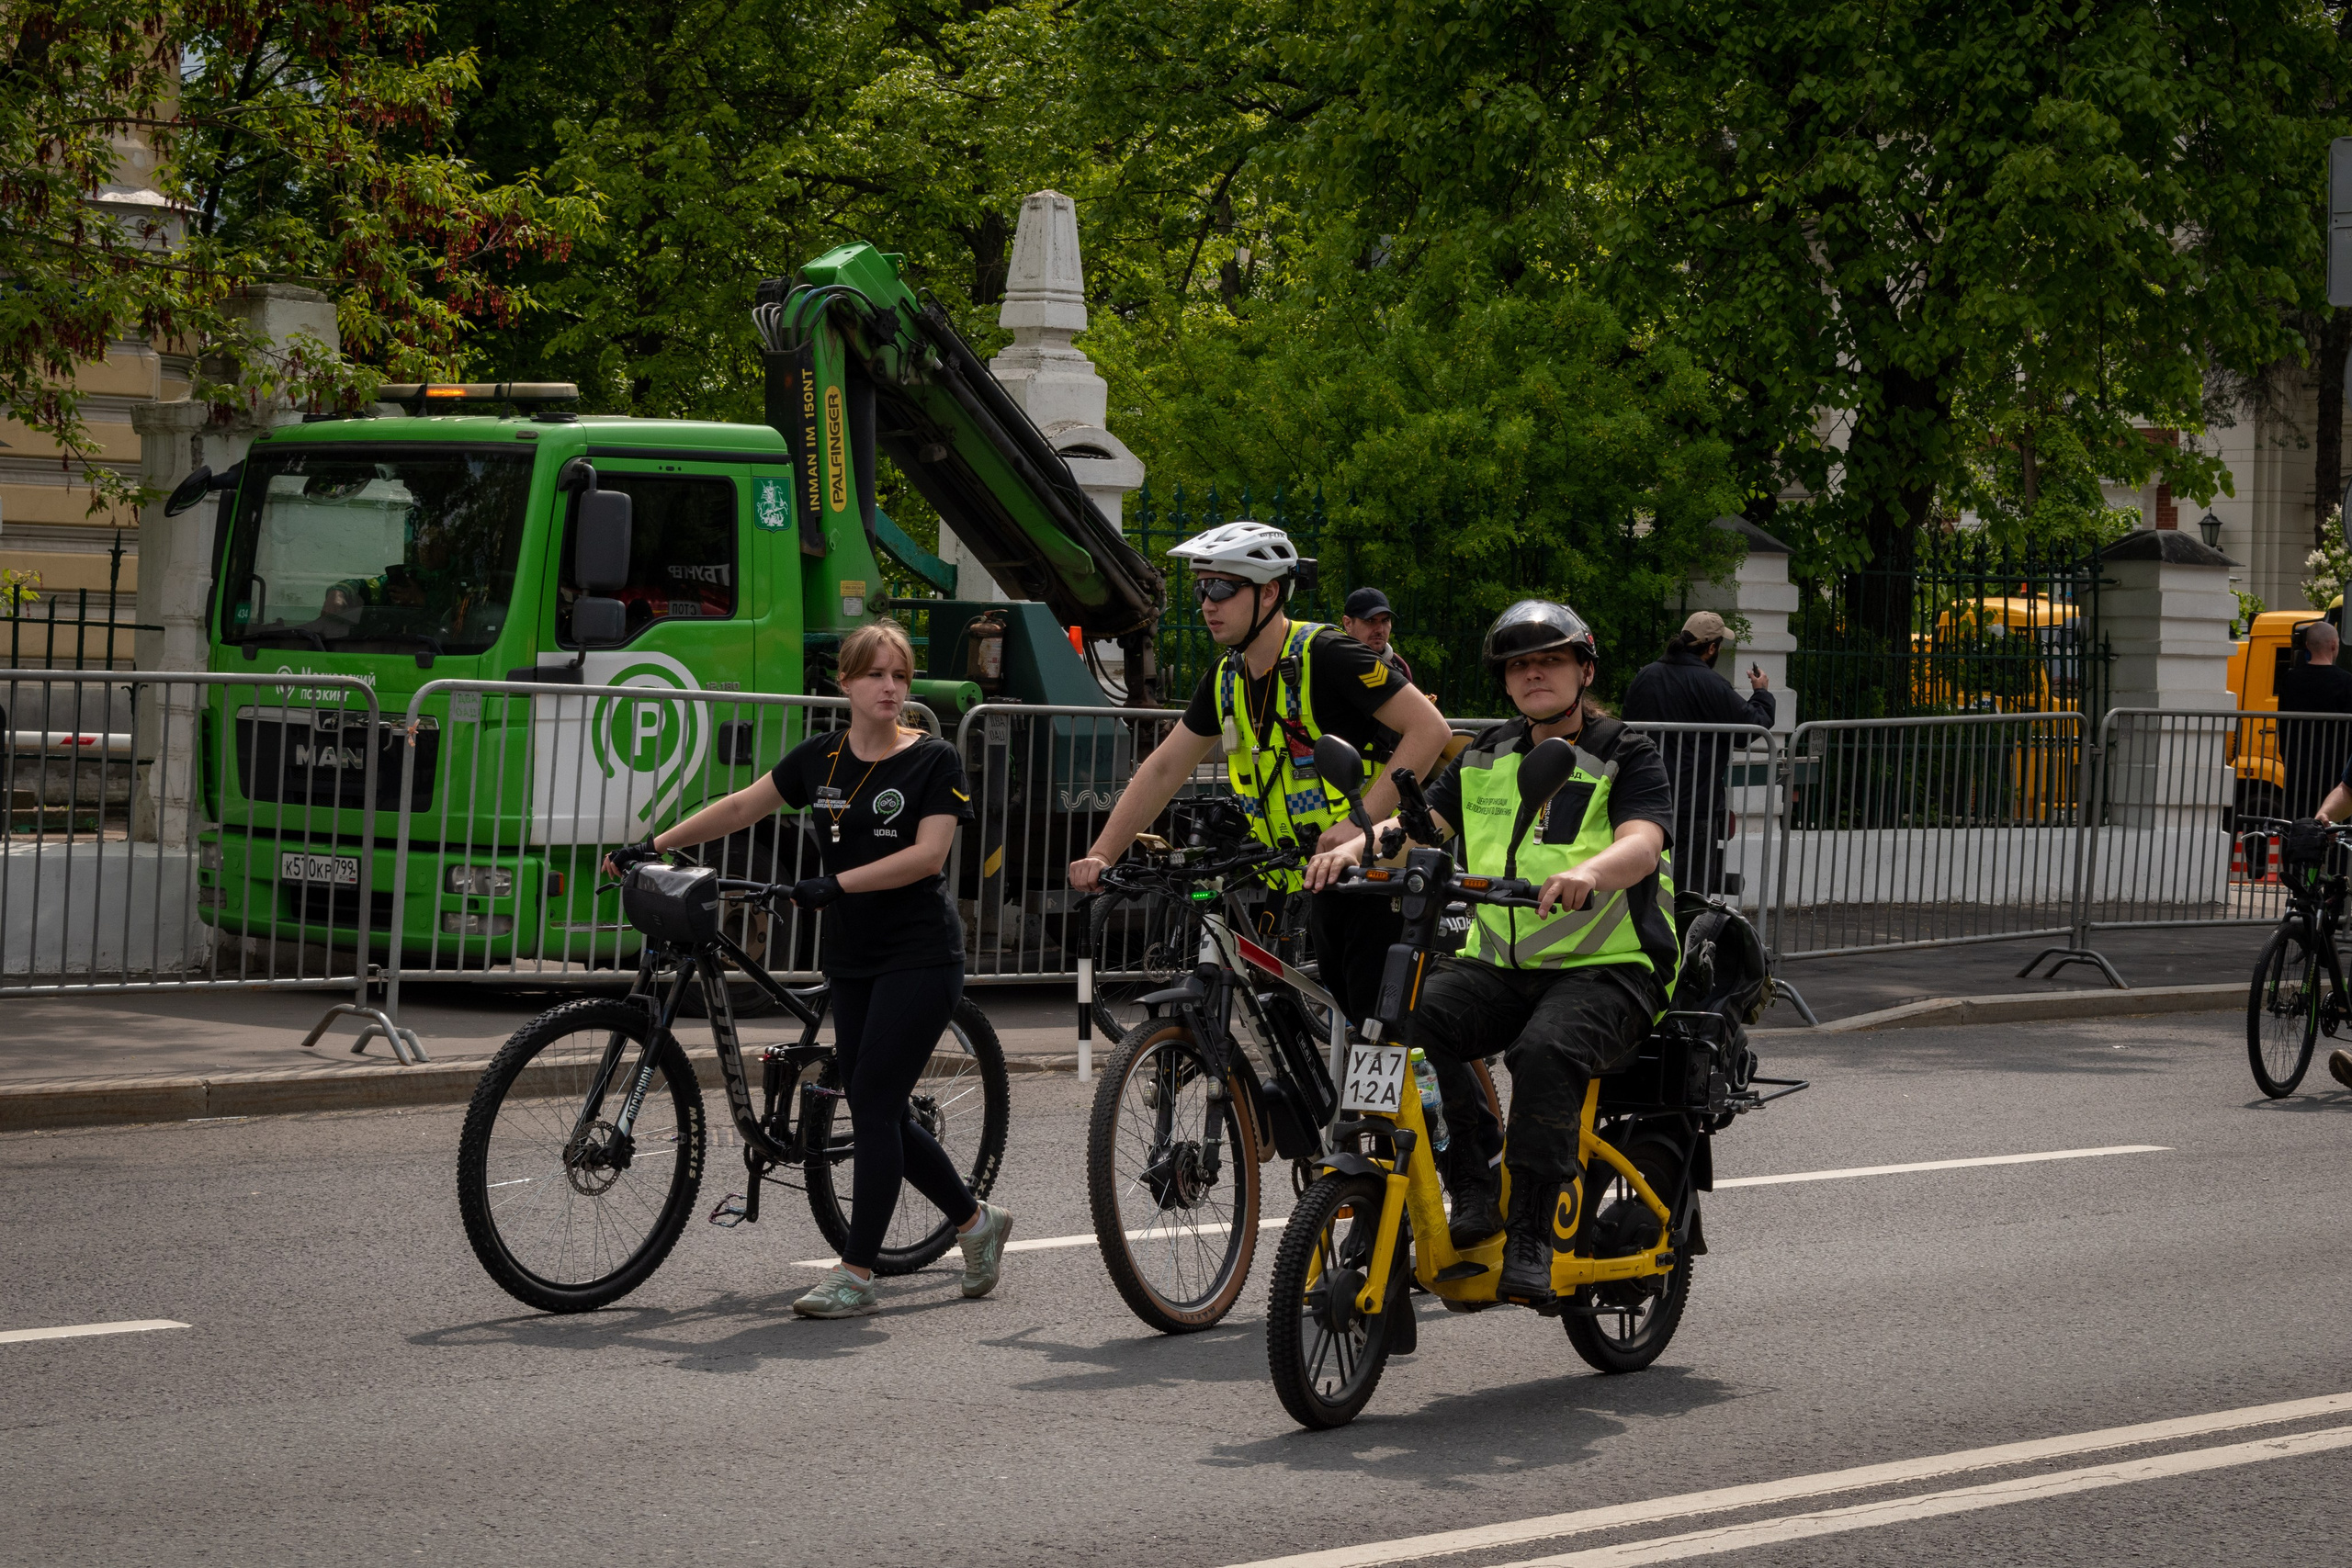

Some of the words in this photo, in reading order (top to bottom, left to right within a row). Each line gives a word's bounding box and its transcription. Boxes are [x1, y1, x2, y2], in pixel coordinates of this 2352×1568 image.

[802, 368, 815, 419] 150NT
[806, 426, 817, 447] IM
[828, 393, 843, 504] PALFINGER
[808, 454, 820, 511] INMAN
[296, 744, 364, 770] MAN
[873, 829, 898, 838] ЦОВД
[286, 857, 331, 878] К50КР
[627, 1066, 655, 1121] ROCKSHOX
[688, 1106, 699, 1179] MAXXIS
